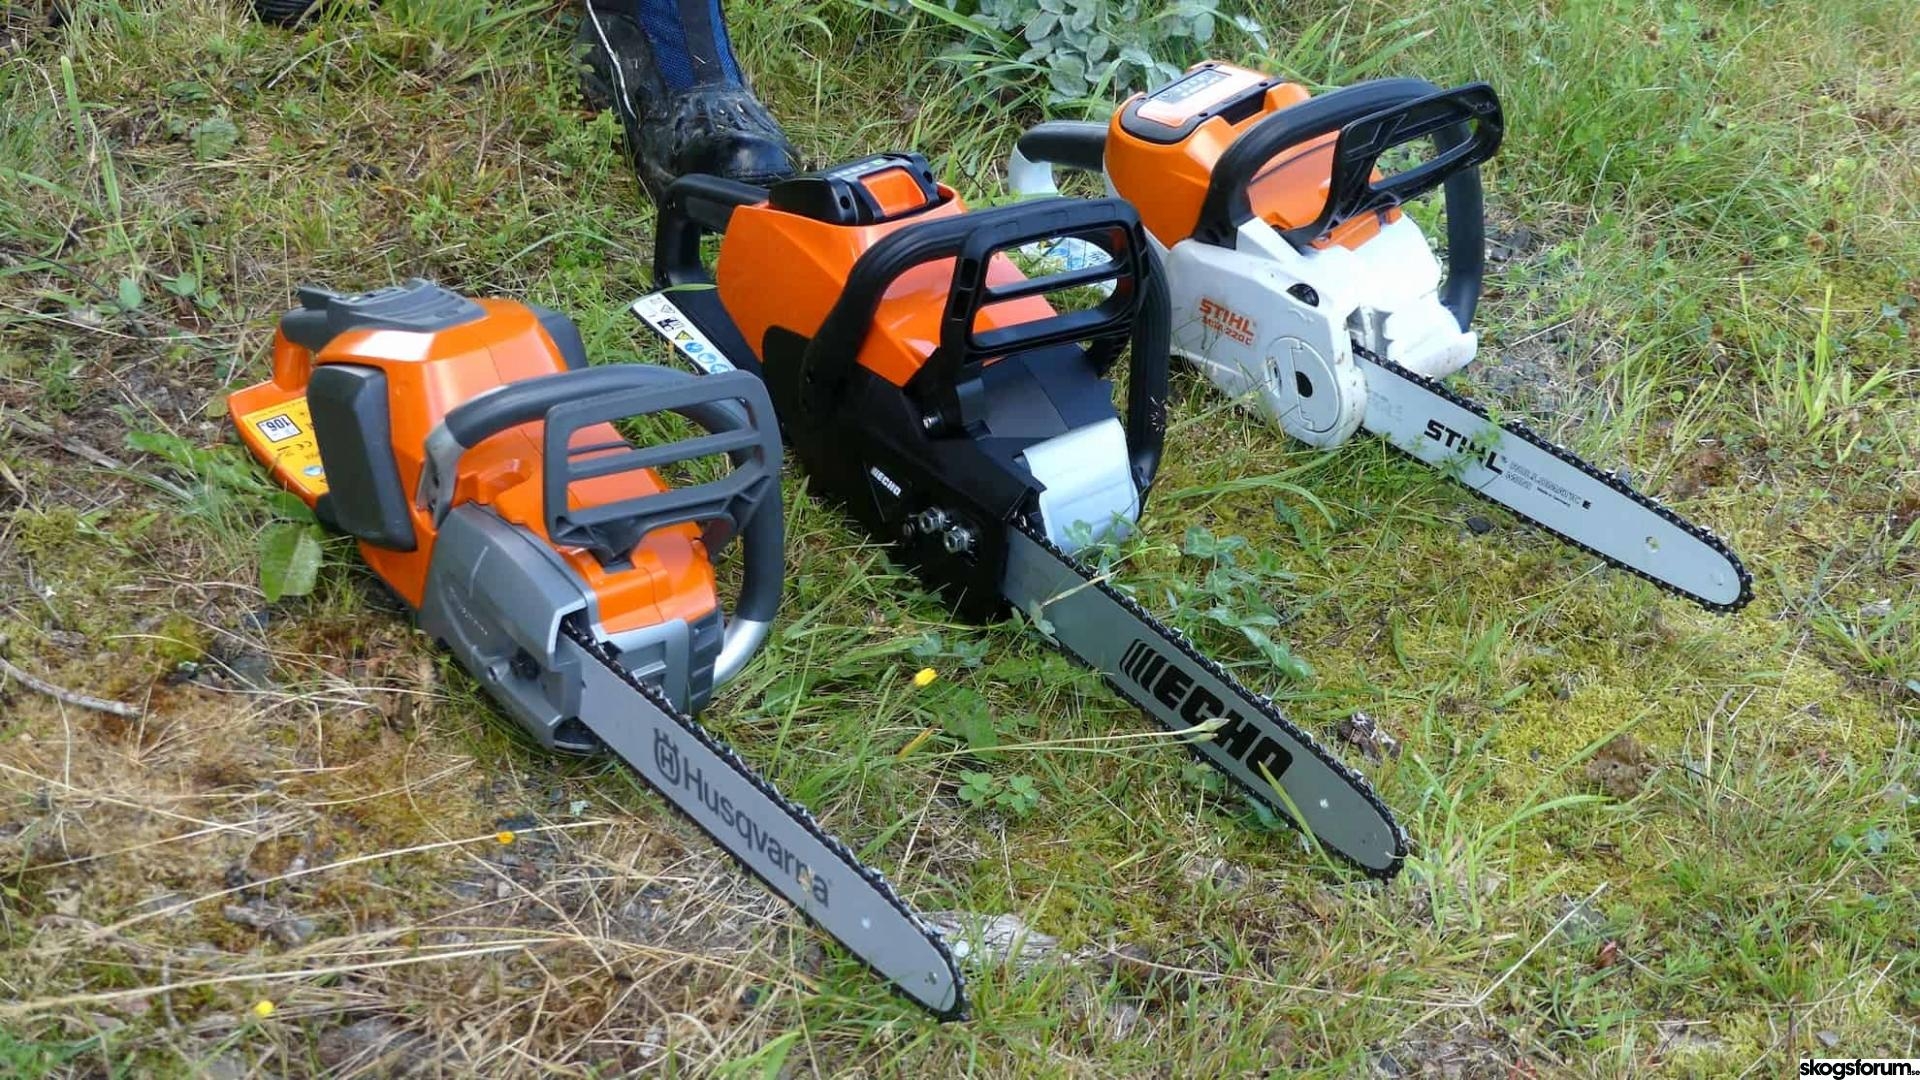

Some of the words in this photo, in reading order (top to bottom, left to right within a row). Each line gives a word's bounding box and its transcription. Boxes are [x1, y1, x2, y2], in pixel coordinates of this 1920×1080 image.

[1199, 297, 1254, 336] STIHL
[266, 417, 290, 431] 106
[874, 468, 902, 497] ECHO
[1152, 664, 1294, 784] ECHO
[683, 757, 830, 907] Husqvarna
